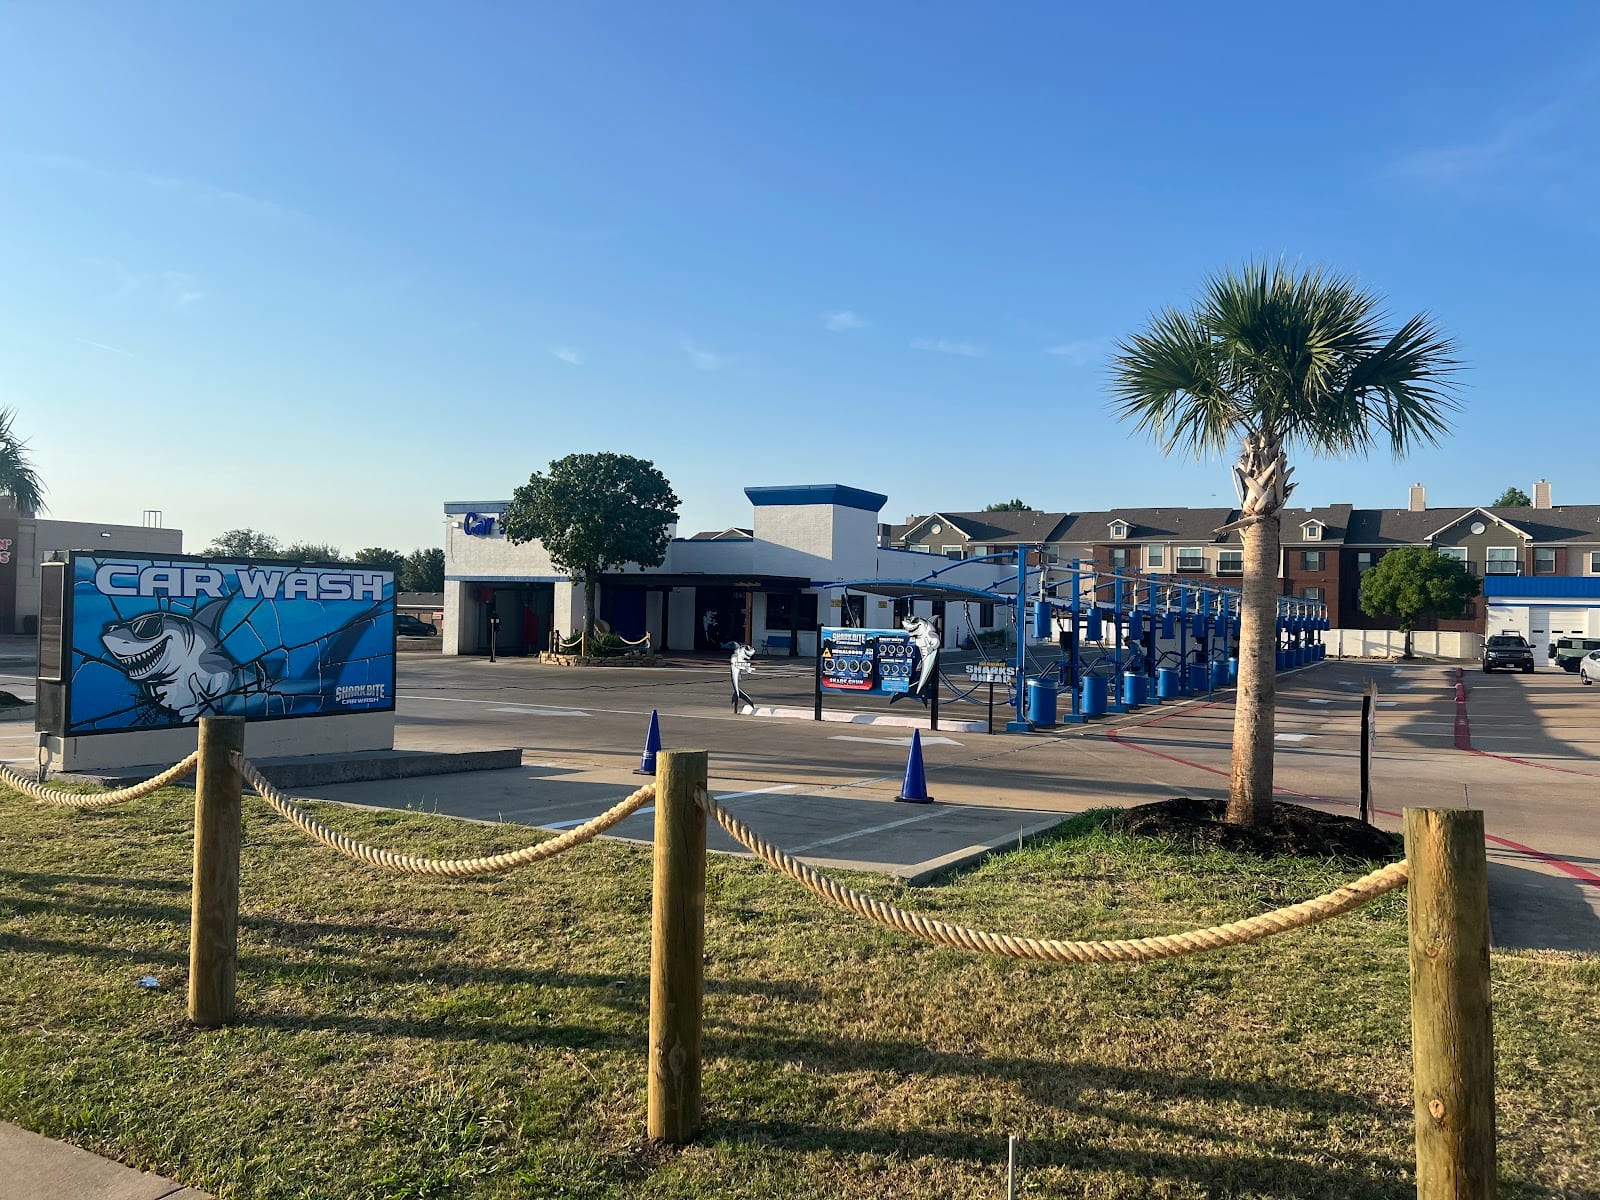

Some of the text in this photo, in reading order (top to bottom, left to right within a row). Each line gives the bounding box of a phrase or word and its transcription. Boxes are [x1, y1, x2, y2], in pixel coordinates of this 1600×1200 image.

[464, 511, 495, 536] Car
[95, 564, 384, 600] CAR WASH
[965, 664, 1015, 676] SHARKS
[970, 674, 1011, 684] AHEAD
[335, 684, 385, 702] SHARKBITE
